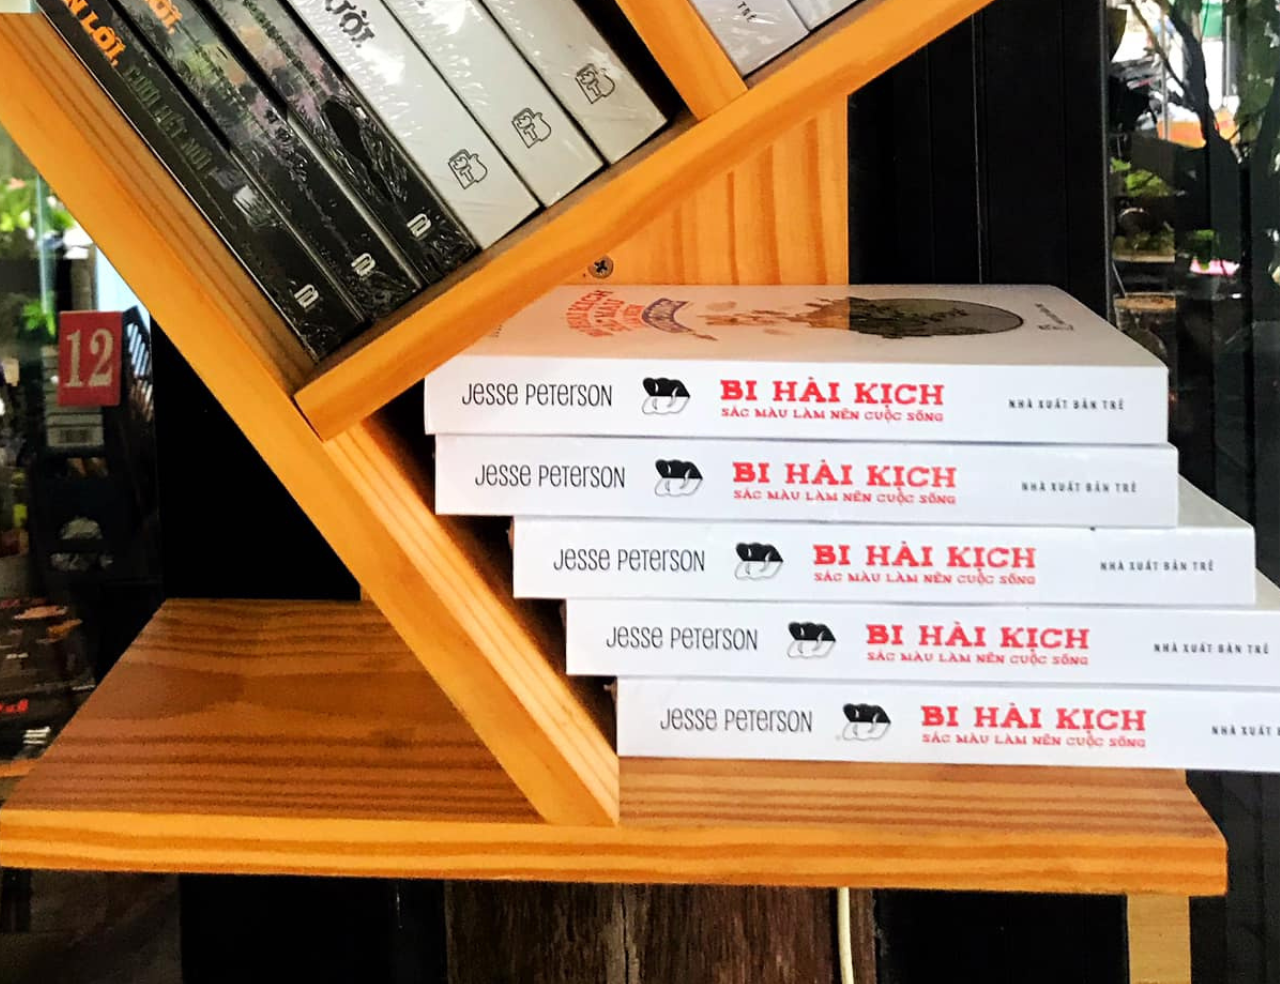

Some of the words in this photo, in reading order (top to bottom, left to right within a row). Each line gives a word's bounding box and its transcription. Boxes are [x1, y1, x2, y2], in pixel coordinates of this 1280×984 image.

[64, 328, 115, 389] 12
[719, 378, 759, 403] BI
[771, 376, 842, 405] HÀI
[853, 381, 945, 410] KỊCH
[731, 460, 771, 485] BI
[784, 460, 854, 488] HÀI
[866, 463, 957, 493] KỊCH
[812, 543, 852, 567] BI
[865, 543, 934, 569] HÀI
[946, 544, 1036, 574] KỊCH
[866, 623, 904, 647] BI
[918, 622, 988, 649] HÀI
[999, 625, 1090, 654] KỊCH
